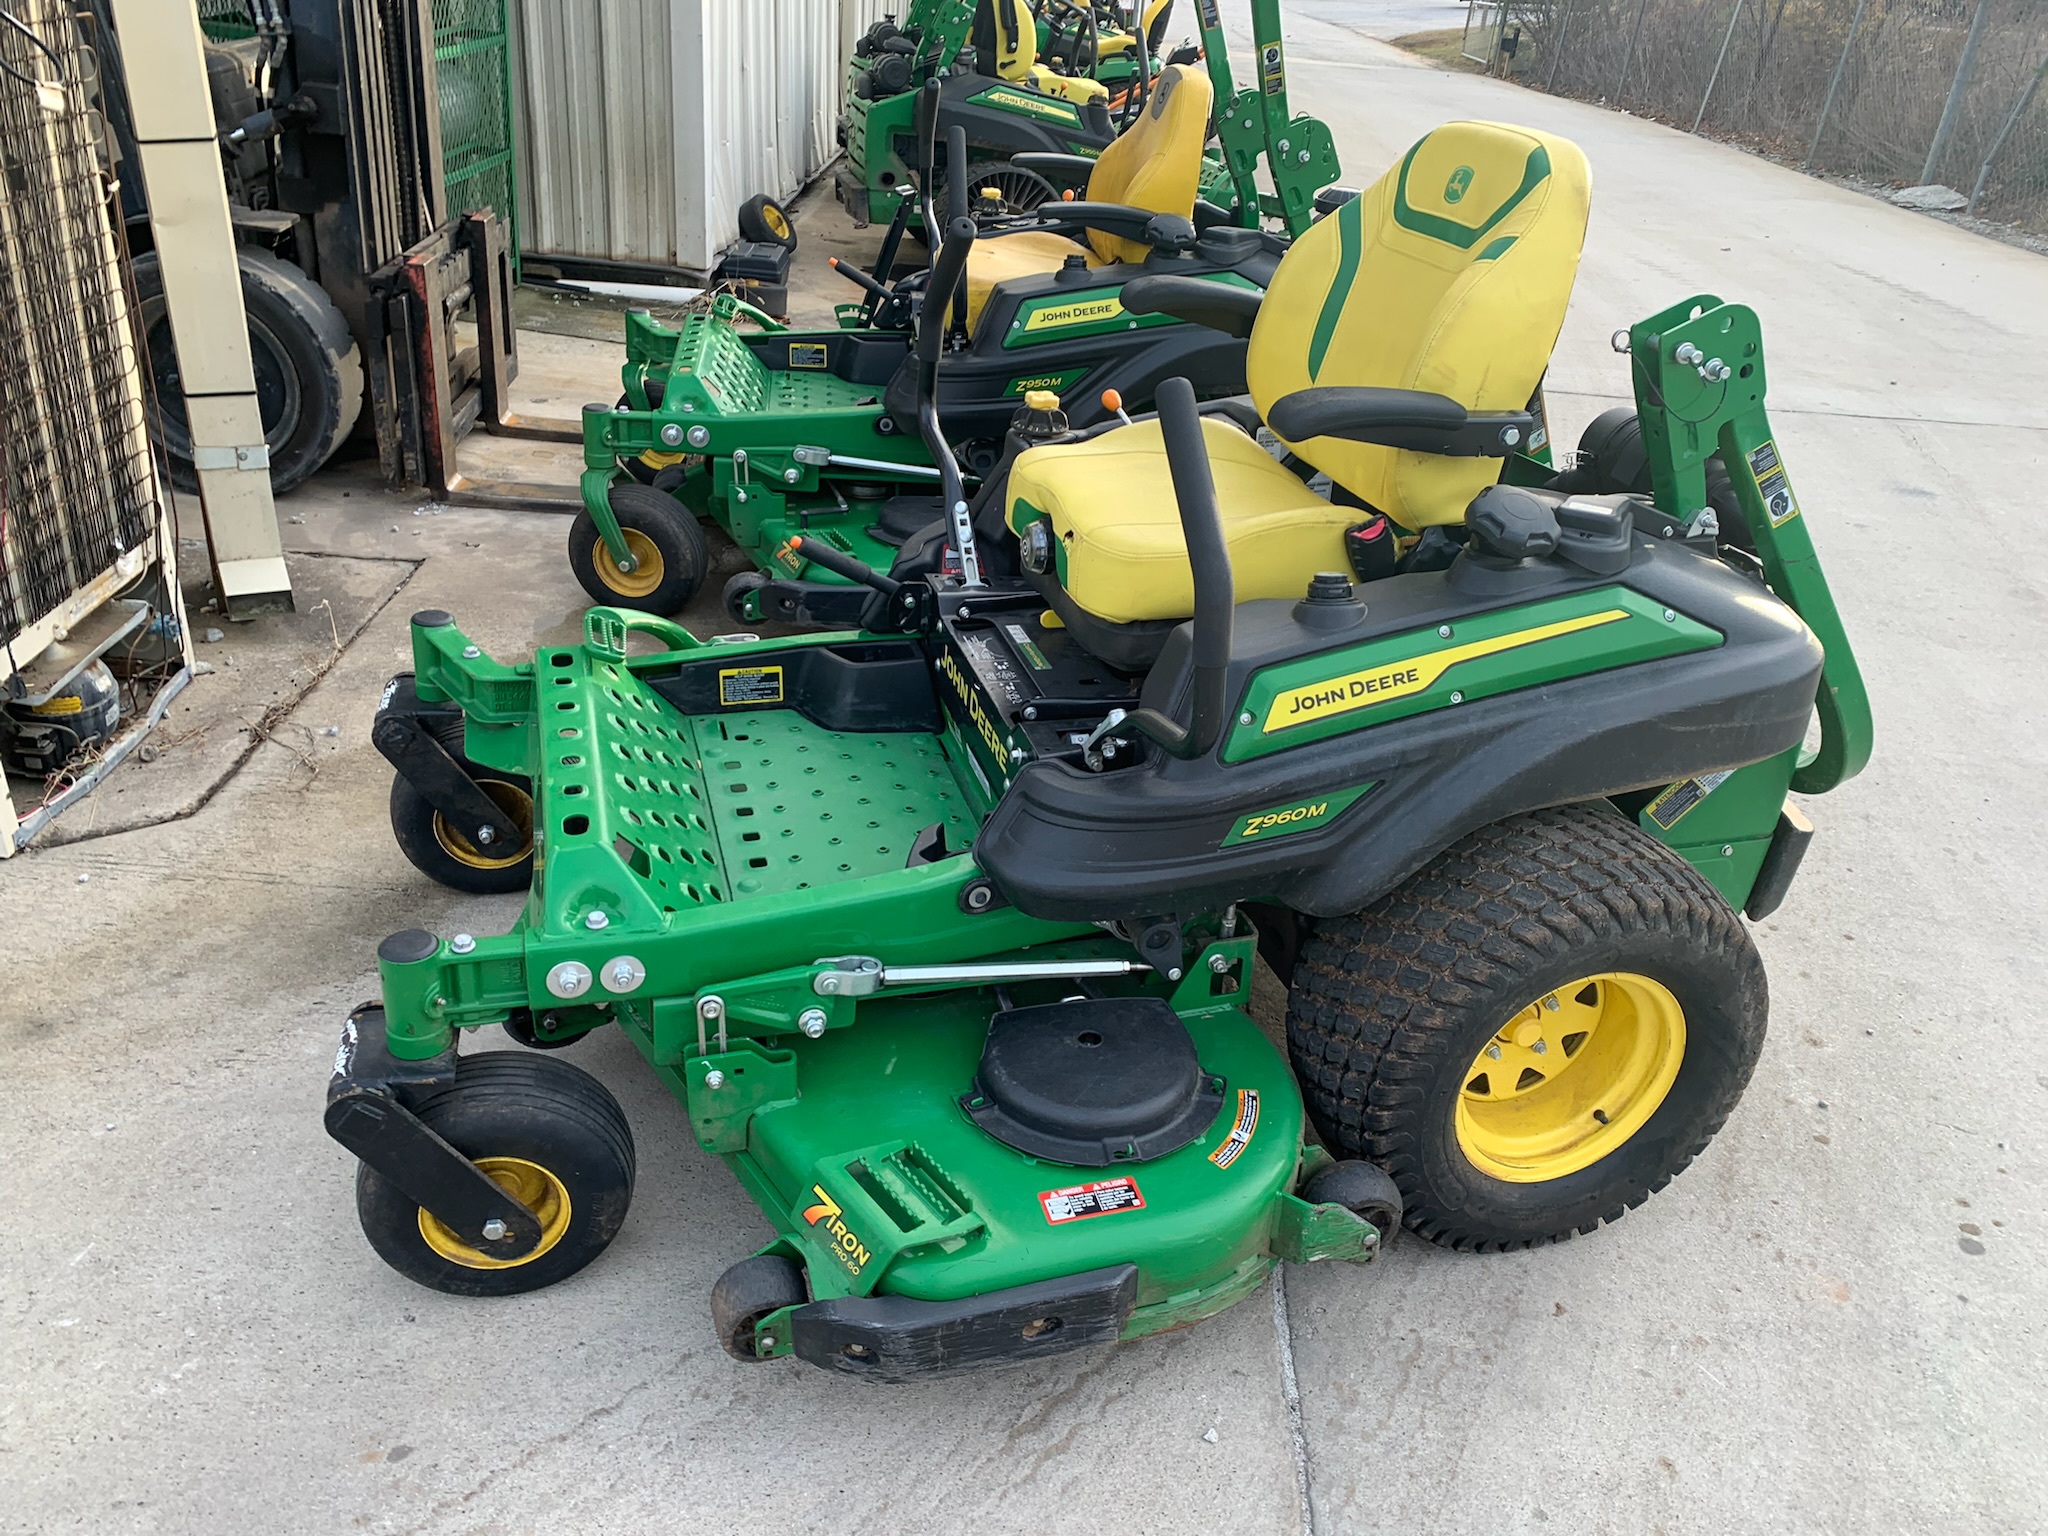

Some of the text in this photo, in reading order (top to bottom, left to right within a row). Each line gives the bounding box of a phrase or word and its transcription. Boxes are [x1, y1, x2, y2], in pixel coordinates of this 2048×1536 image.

[997, 93, 1046, 112] JOHN DEERE
[1040, 304, 1112, 323] JOHN DEERE
[1015, 377, 1062, 392] Z950M
[1290, 668, 1419, 714] JOHN DEERE
[941, 644, 969, 706] JOHN
[970, 688, 1008, 775] DEERE
[1242, 802, 1328, 837] Z960M
[1058, 1178, 1128, 1196] DANGER PELIGRO
[830, 1241, 860, 1276] PRO 60
